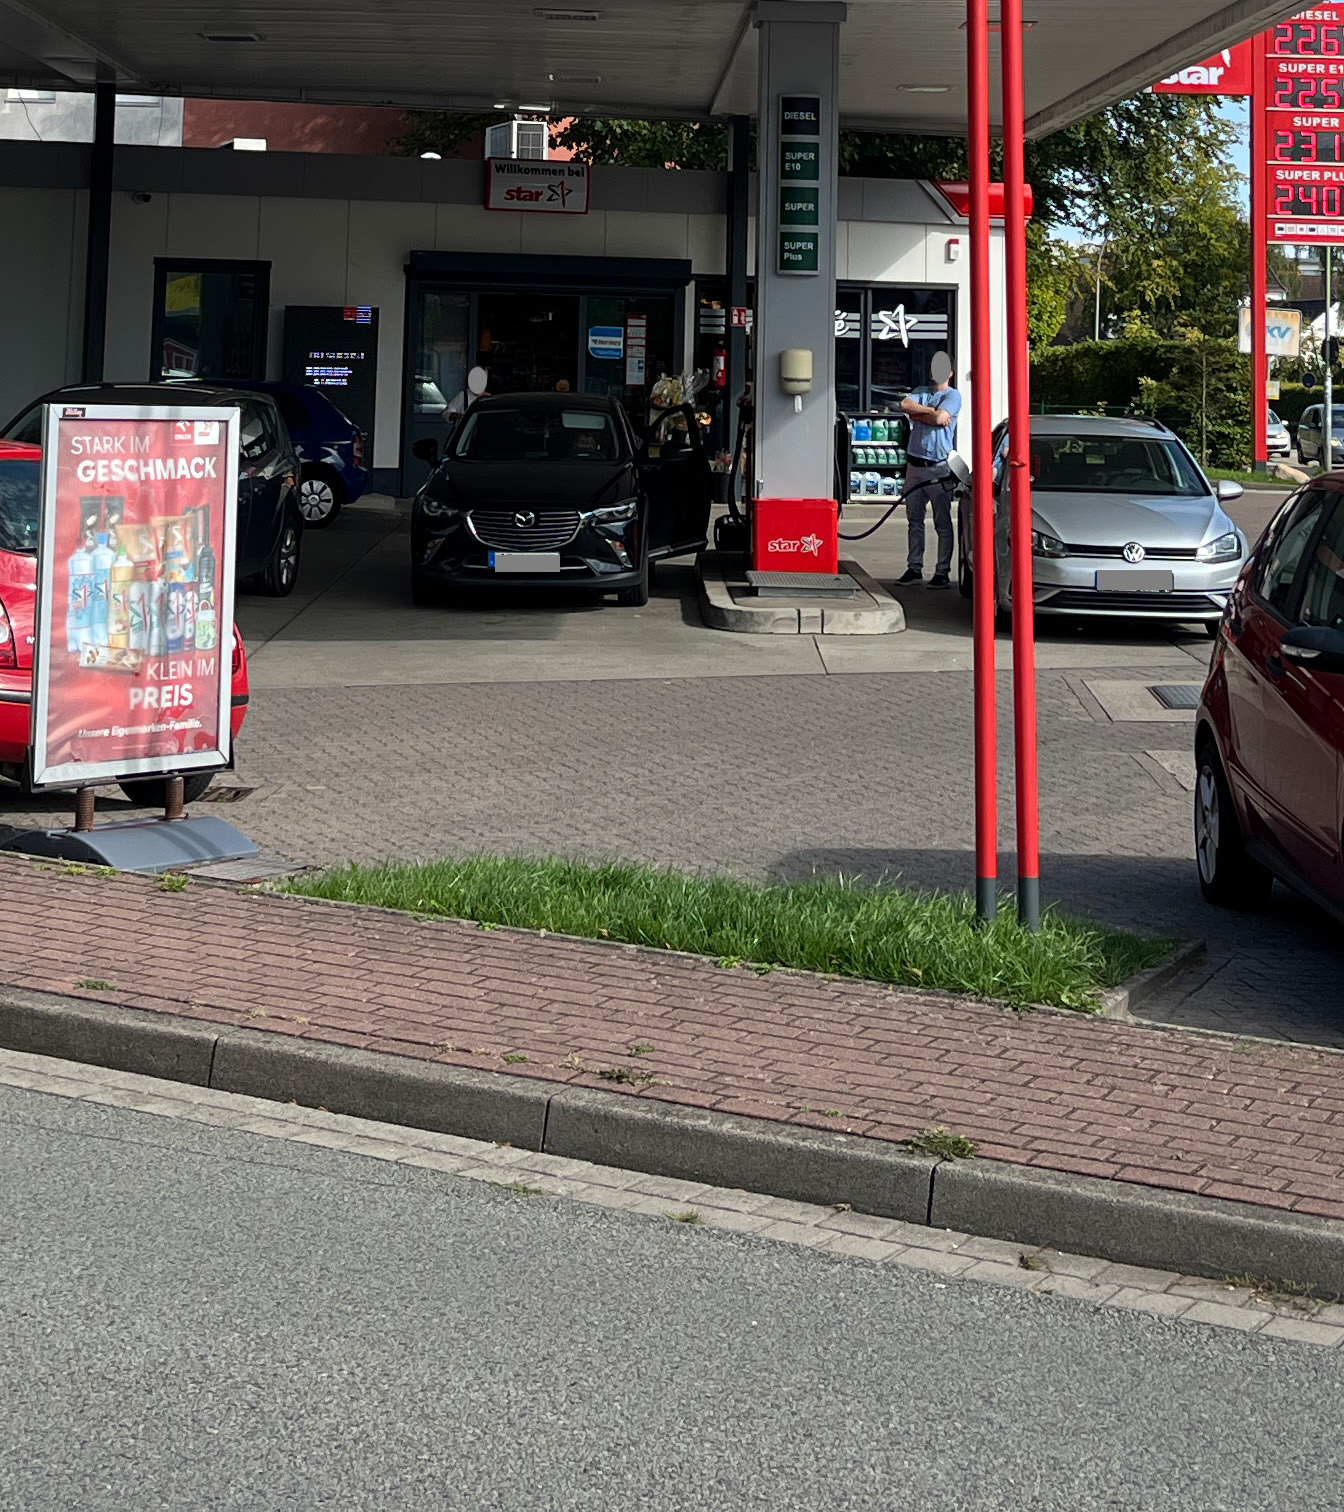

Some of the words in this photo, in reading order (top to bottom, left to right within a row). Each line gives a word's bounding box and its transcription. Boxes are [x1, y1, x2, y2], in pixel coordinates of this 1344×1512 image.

[1278, 63, 1325, 74] SUPER
[784, 111, 817, 121] DIESEL
[1293, 116, 1339, 128] SUPER
[785, 151, 815, 161] SUPER
[494, 163, 565, 177] Willkommen
[568, 166, 585, 177] bei
[785, 163, 801, 171] E10
[1276, 169, 1321, 181] SUPER
[504, 186, 543, 202] star
[784, 202, 815, 211] SUPER
[784, 241, 814, 251] SUPER
[784, 252, 803, 261] Plus
[70, 435, 126, 455] STARK
[130, 436, 150, 454] IM
[76, 456, 217, 483] GESCHMACK
[768, 538, 800, 552] star
[146, 659, 193, 680] KLEIN
[197, 658, 215, 676] IM
[129, 683, 193, 710] PREIS
